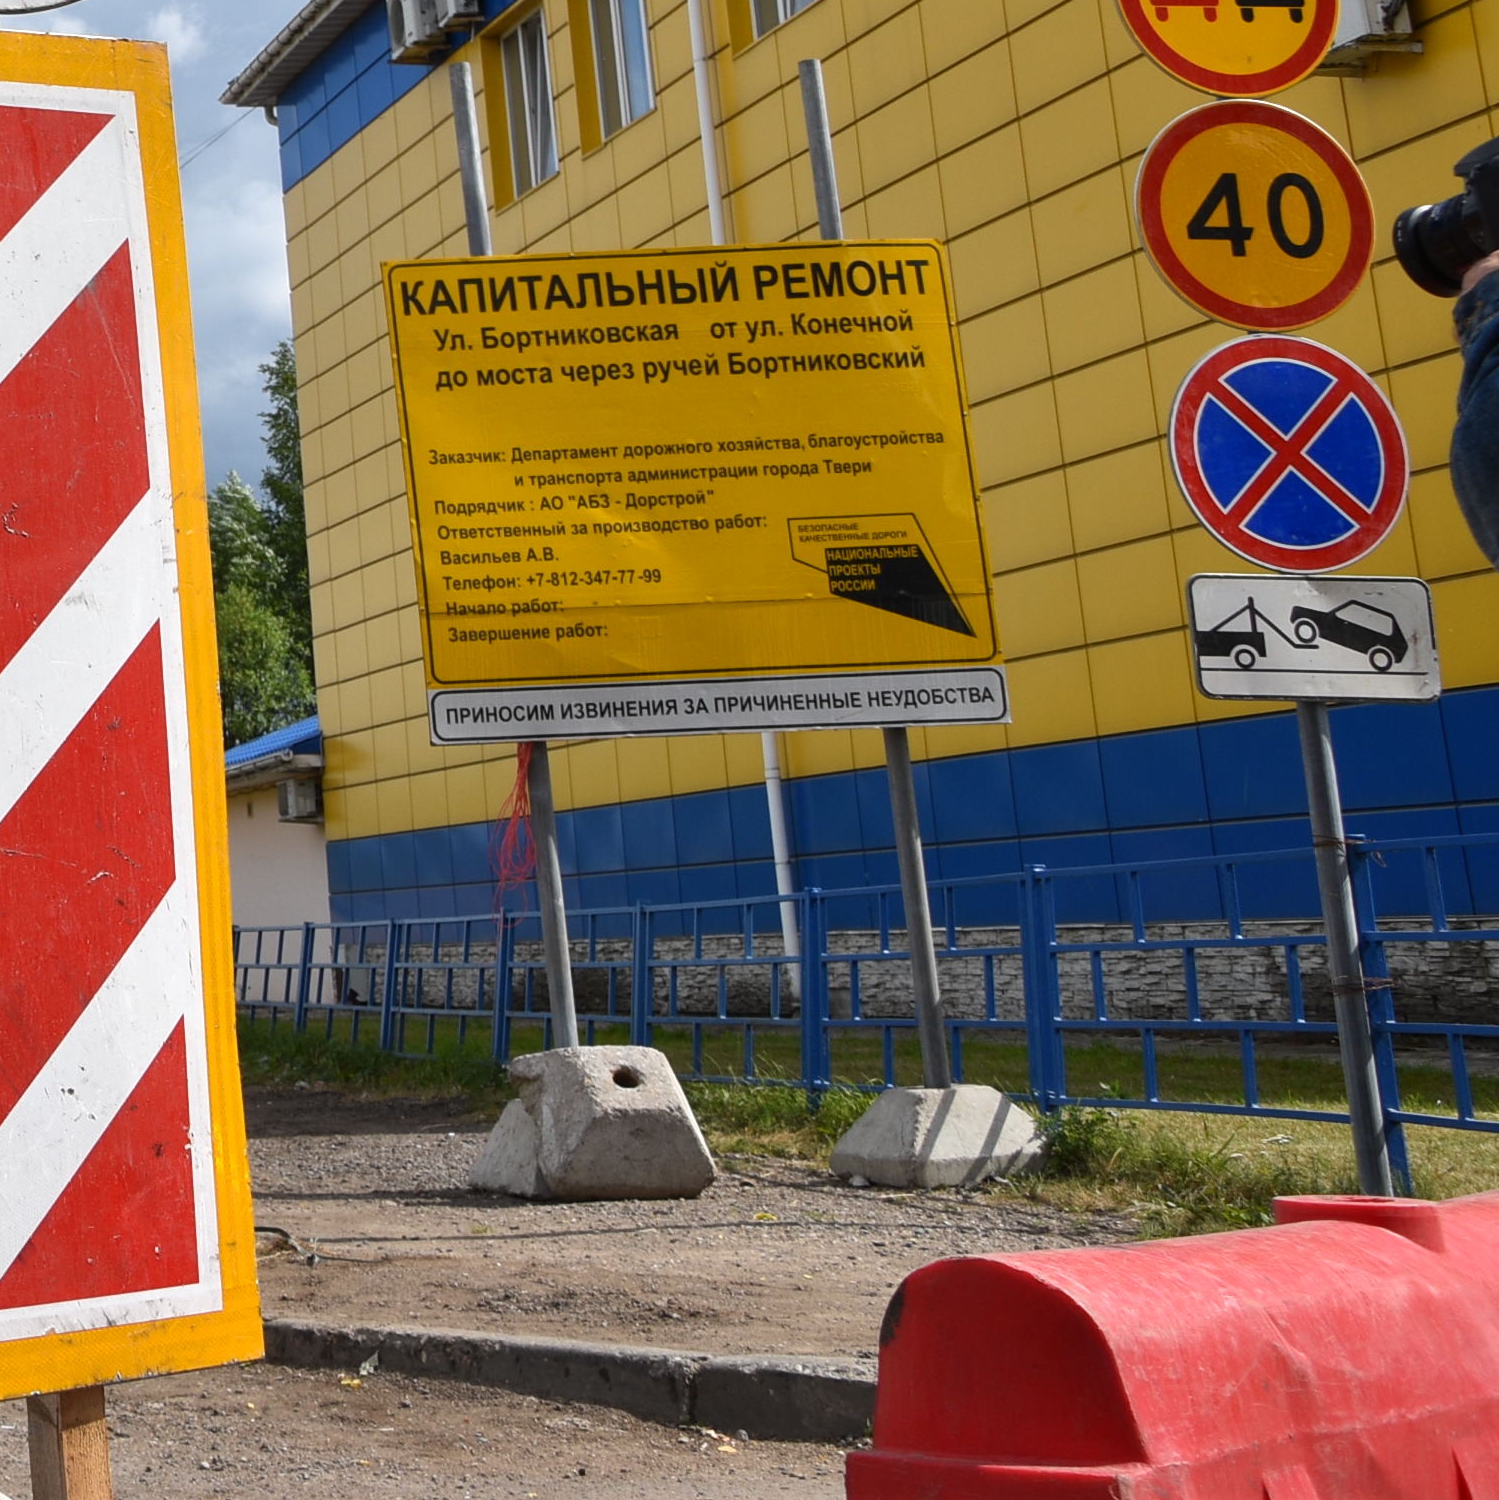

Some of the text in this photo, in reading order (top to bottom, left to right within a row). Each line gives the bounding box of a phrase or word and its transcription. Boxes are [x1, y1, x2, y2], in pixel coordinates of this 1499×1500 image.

[1187, 173, 1324, 259] 40
[400, 259, 929, 316] КАПИТАЛЬНЫЙ РЕМОНТ
[433, 309, 913, 353] Ул. Бортниковская от ул. Конечной
[436, 345, 925, 392] до моста через ручей Бортниковский
[428, 430, 944, 465] Заказчик: Департамент дорожного хозяйства, благоустройства
[514, 459, 872, 489] и транспорта администрации города Твери
[434, 500, 525, 517] Подрядчик
[540, 496, 564, 510] АО
[437, 513, 768, 540] Ответственный за производство работ:
[440, 547, 559, 565] Васильев А.В.
[827, 546, 919, 562] НАЦИОНАЛЬНЫЕ
[829, 564, 881, 576] ПРОЕКТЫ
[443, 574, 521, 592] Телефон:
[831, 579, 876, 592] РОССИИ
[446, 598, 564, 617] Начало работ:
[448, 623, 608, 644] Завершение работ:
[446, 686, 995, 725] ПРИНОСИМ ИЗВИНЕНИЯ ЗА ПРИЧИНЕННЫЕ НЕУДОБСТВА
